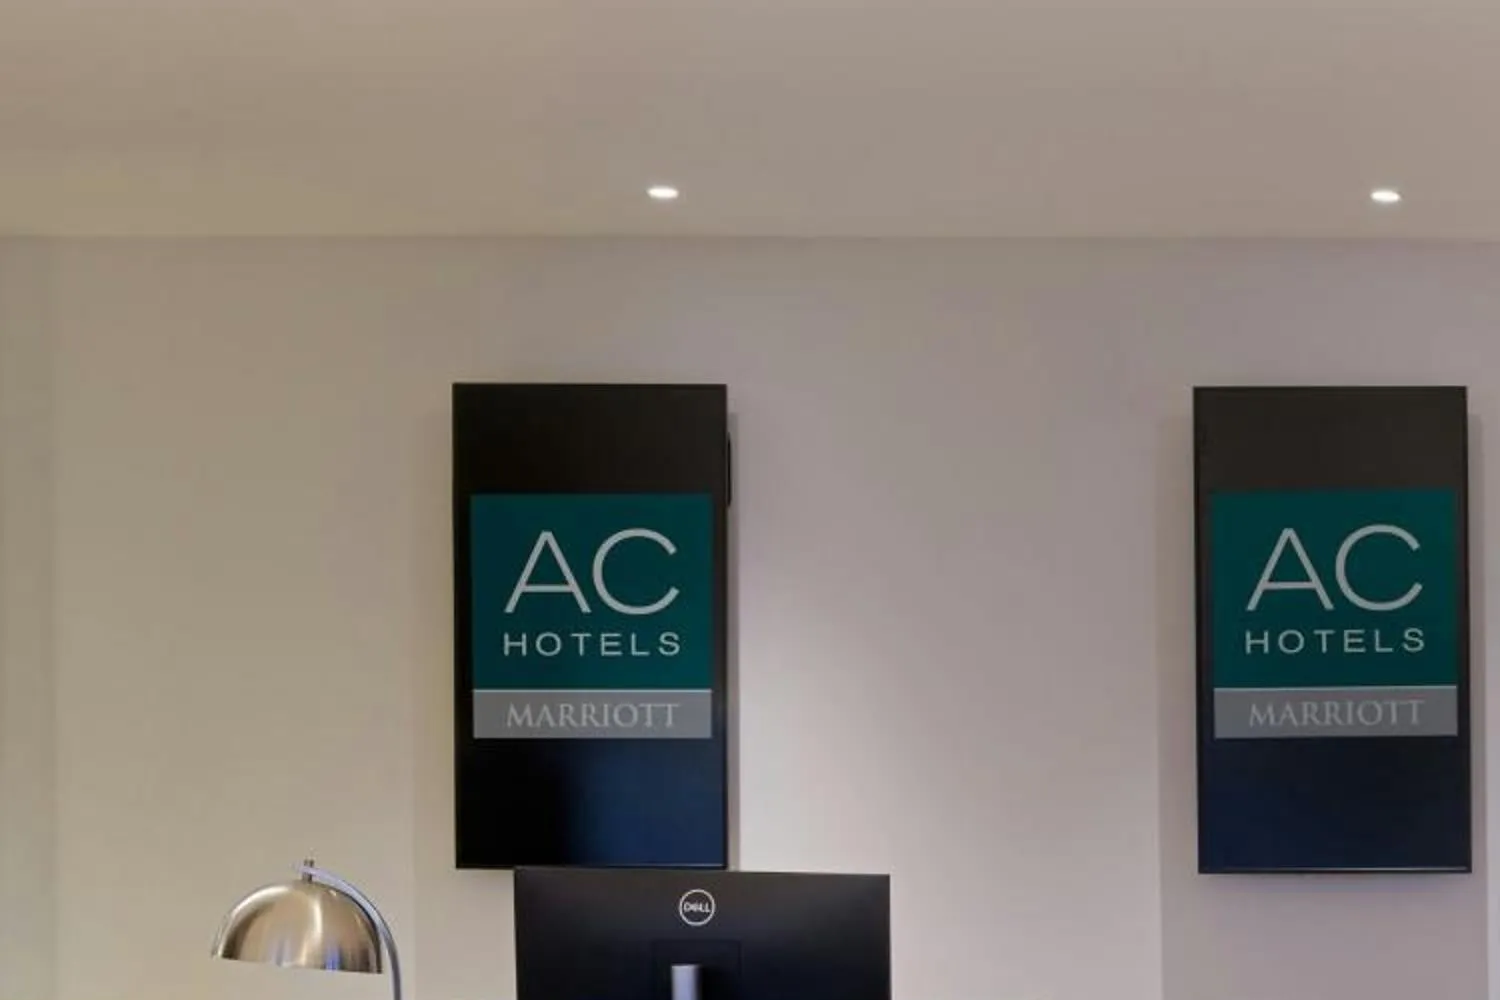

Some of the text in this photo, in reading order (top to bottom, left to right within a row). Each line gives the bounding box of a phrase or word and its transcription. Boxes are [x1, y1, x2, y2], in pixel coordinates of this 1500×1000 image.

[504, 527, 681, 615] AC
[1245, 523, 1424, 612] AC
[503, 631, 681, 657] HOTELS
[1245, 628, 1425, 654] HOTELS
[505, 702, 680, 728] MARRIOTT
[1248, 699, 1425, 727] MARRIOTT
[683, 901, 711, 913] DELL
